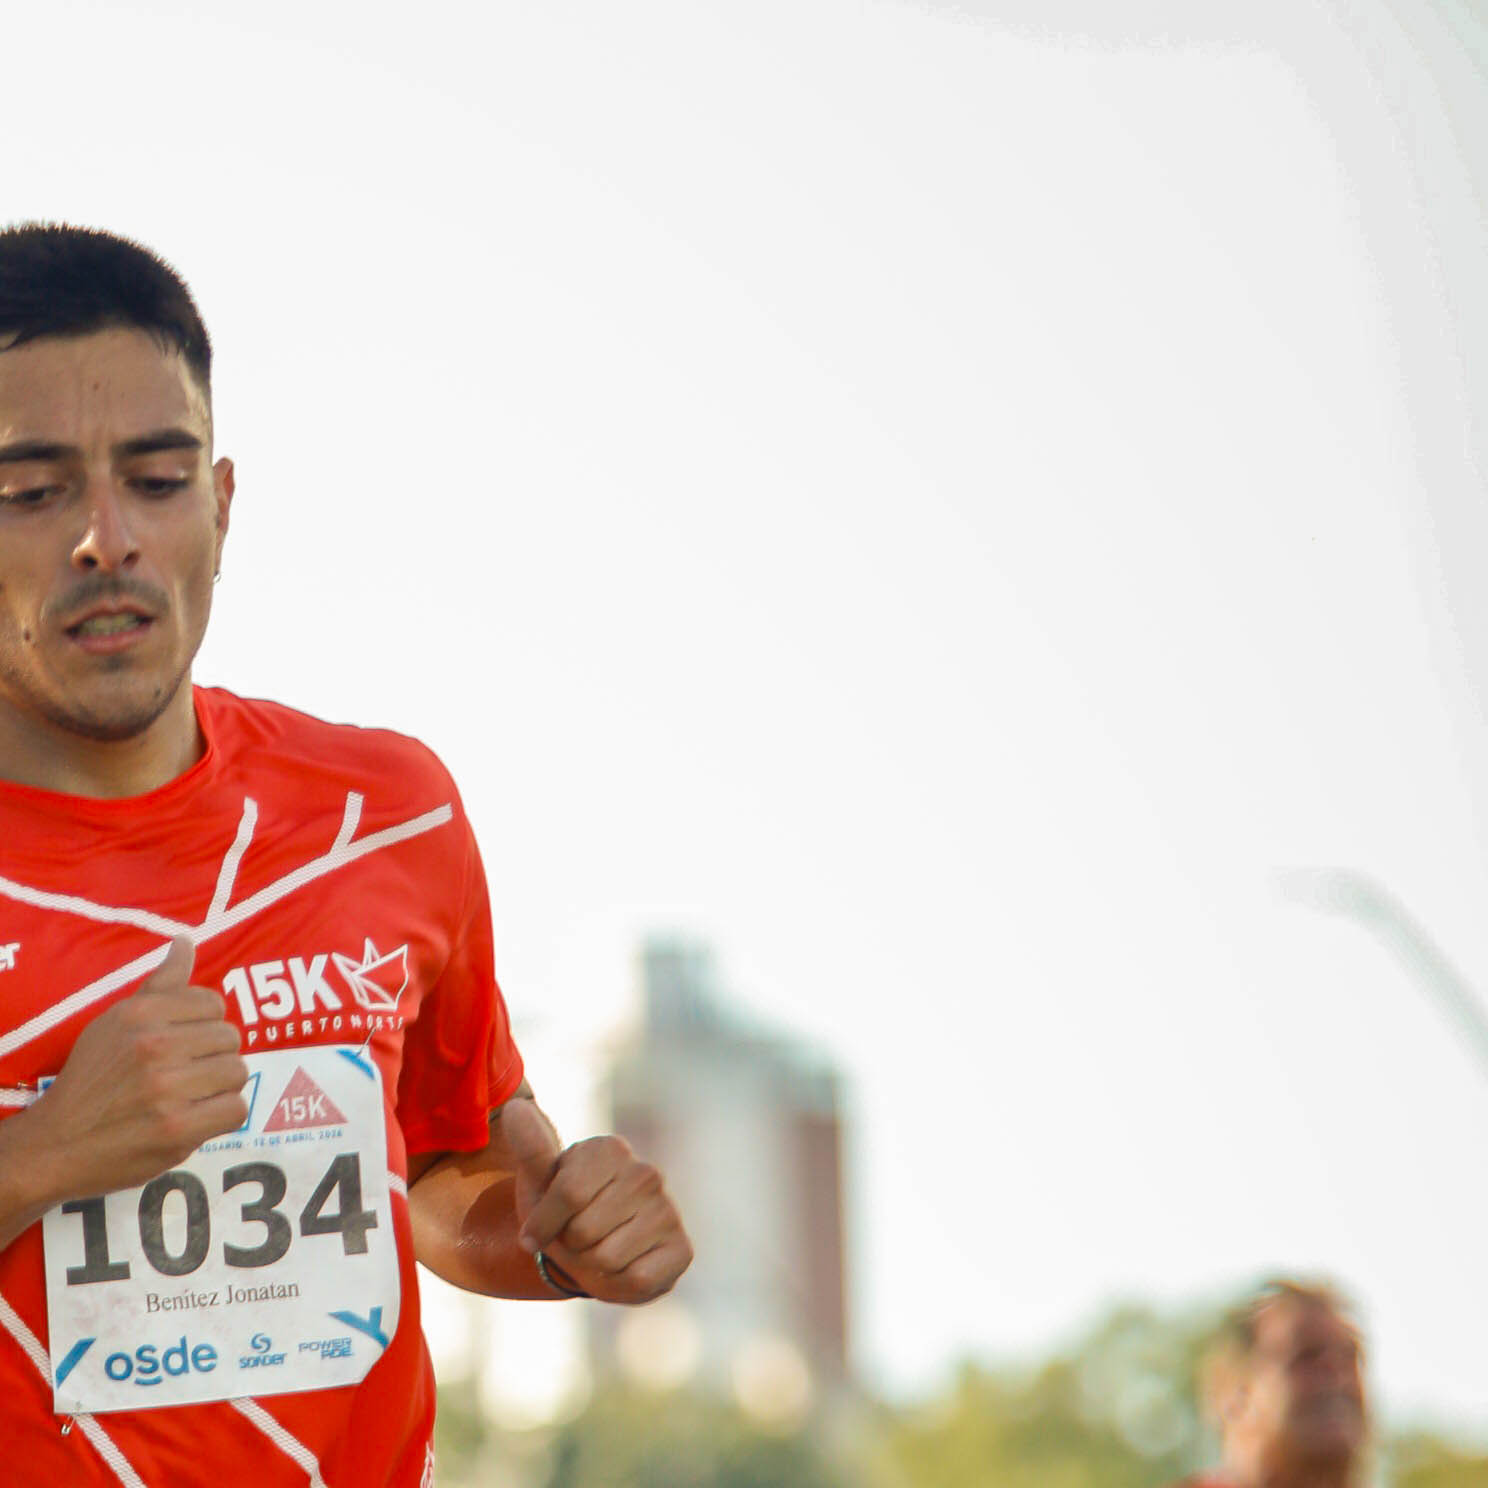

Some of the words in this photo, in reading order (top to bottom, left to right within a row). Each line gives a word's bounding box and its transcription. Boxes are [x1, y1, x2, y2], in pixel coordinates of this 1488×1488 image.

[222, 953, 343, 1025] 15K
[248, 1015, 342, 1046] PUERTO
[280, 1094, 327, 1123] 15K
[285, 1131, 315, 1144] ABRIL
[61, 1152, 379, 1286] 1034
[226, 1282, 300, 1305] Jonatan
[105, 1335, 218, 1383] osde
